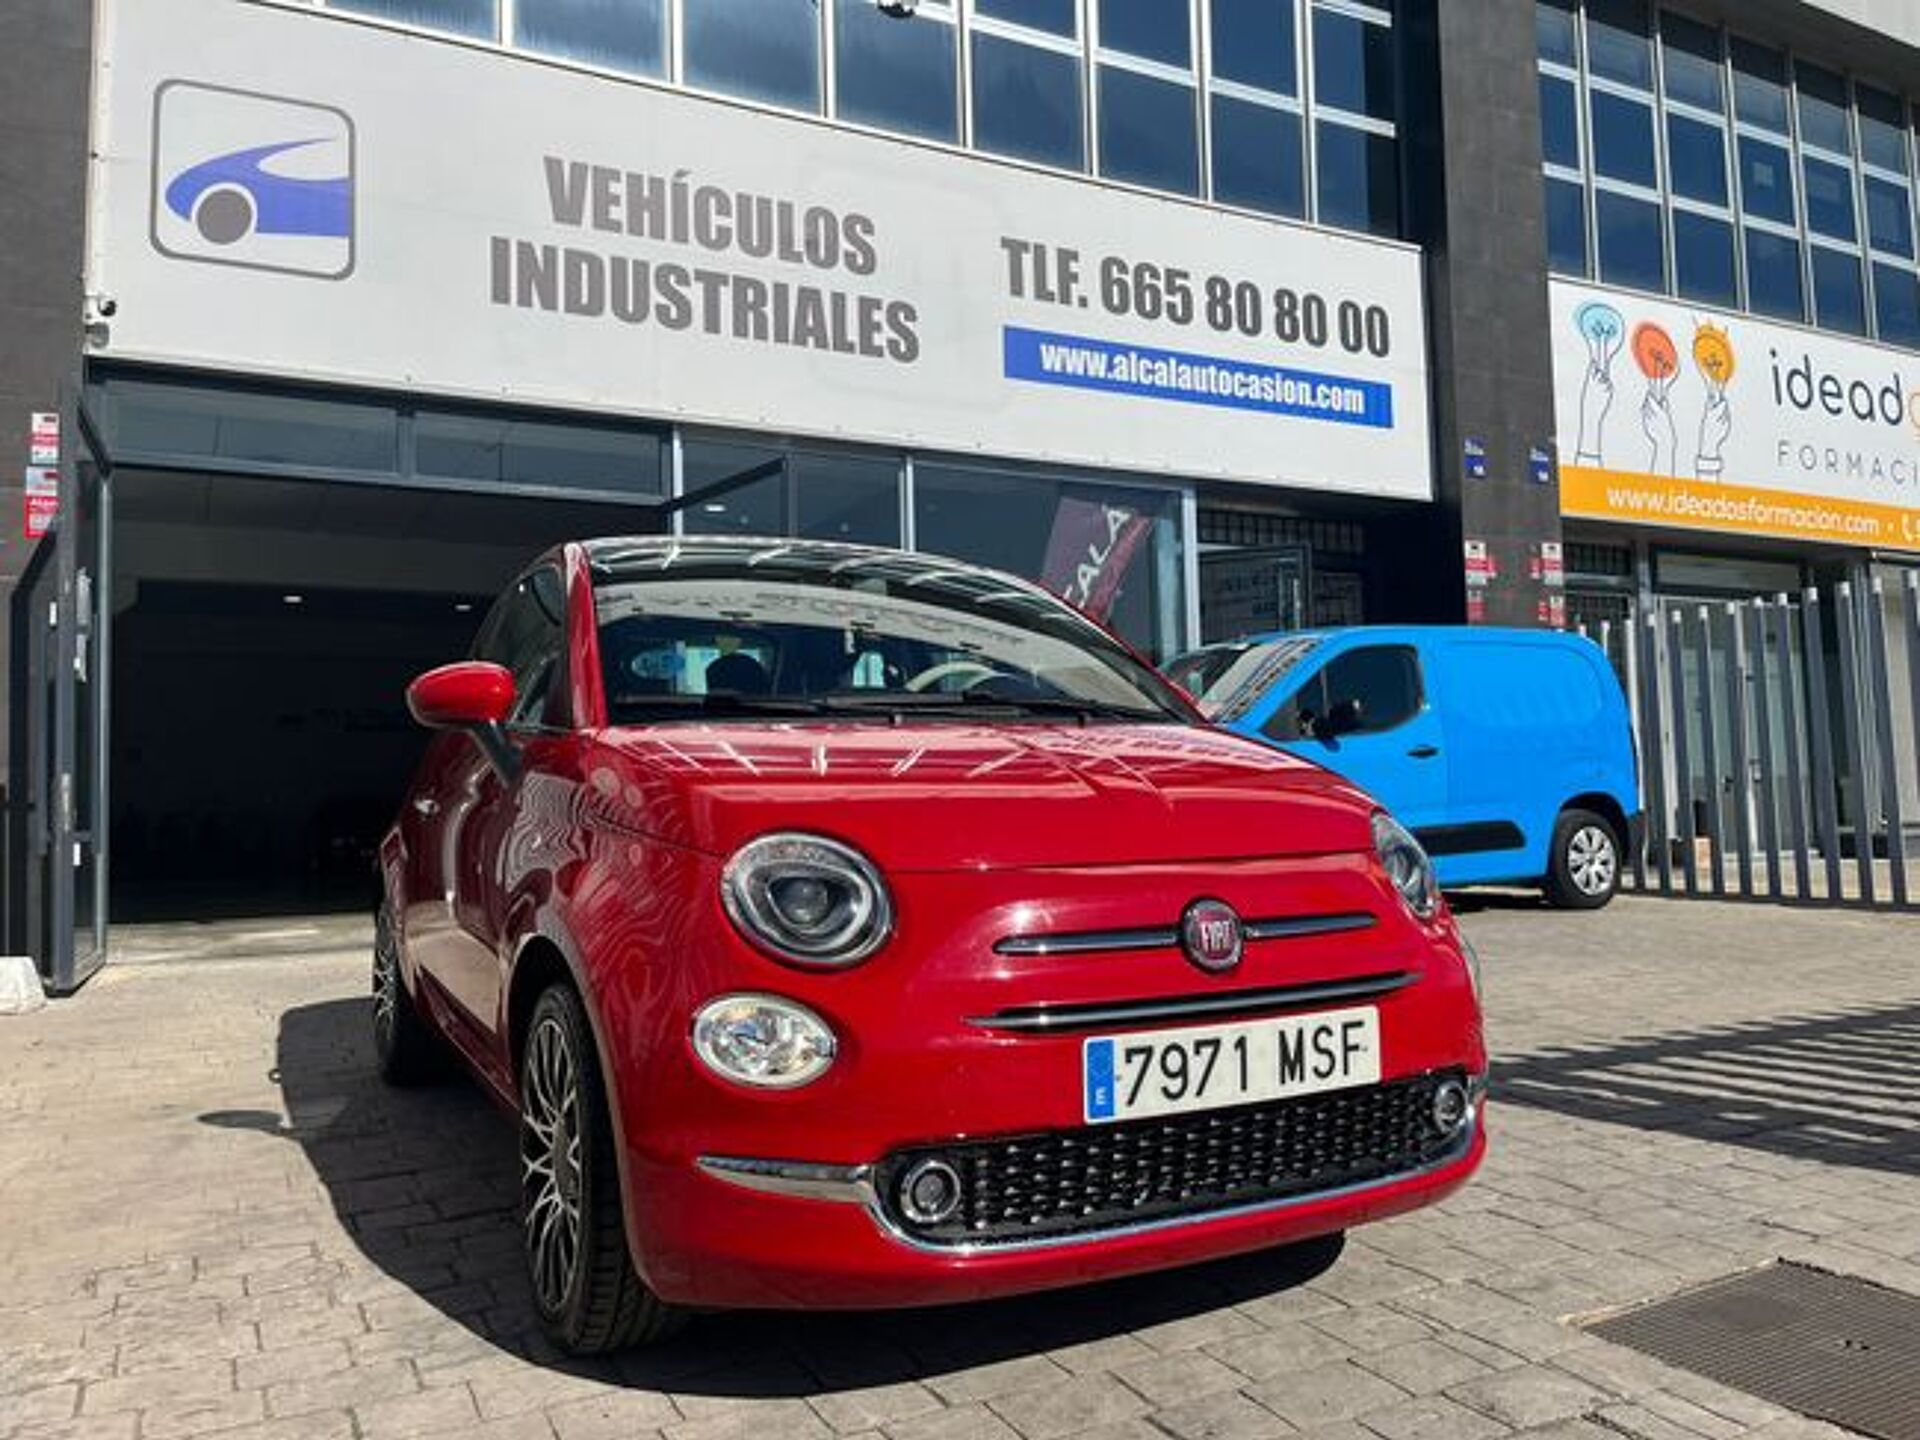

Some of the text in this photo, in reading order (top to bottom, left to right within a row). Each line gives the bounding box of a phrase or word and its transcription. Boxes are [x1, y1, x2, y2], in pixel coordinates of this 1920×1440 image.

[543, 156, 877, 277] VEHÍCULOS
[490, 235, 920, 364] INDUSTRIALES
[1001, 236, 1390, 358] TLF. 665 80 80 00
[1039, 341, 1365, 415] www.alcalautocasion.com
[1094, 1087, 1106, 1107] E
[1124, 1020, 1365, 1107] 7971 MSF
